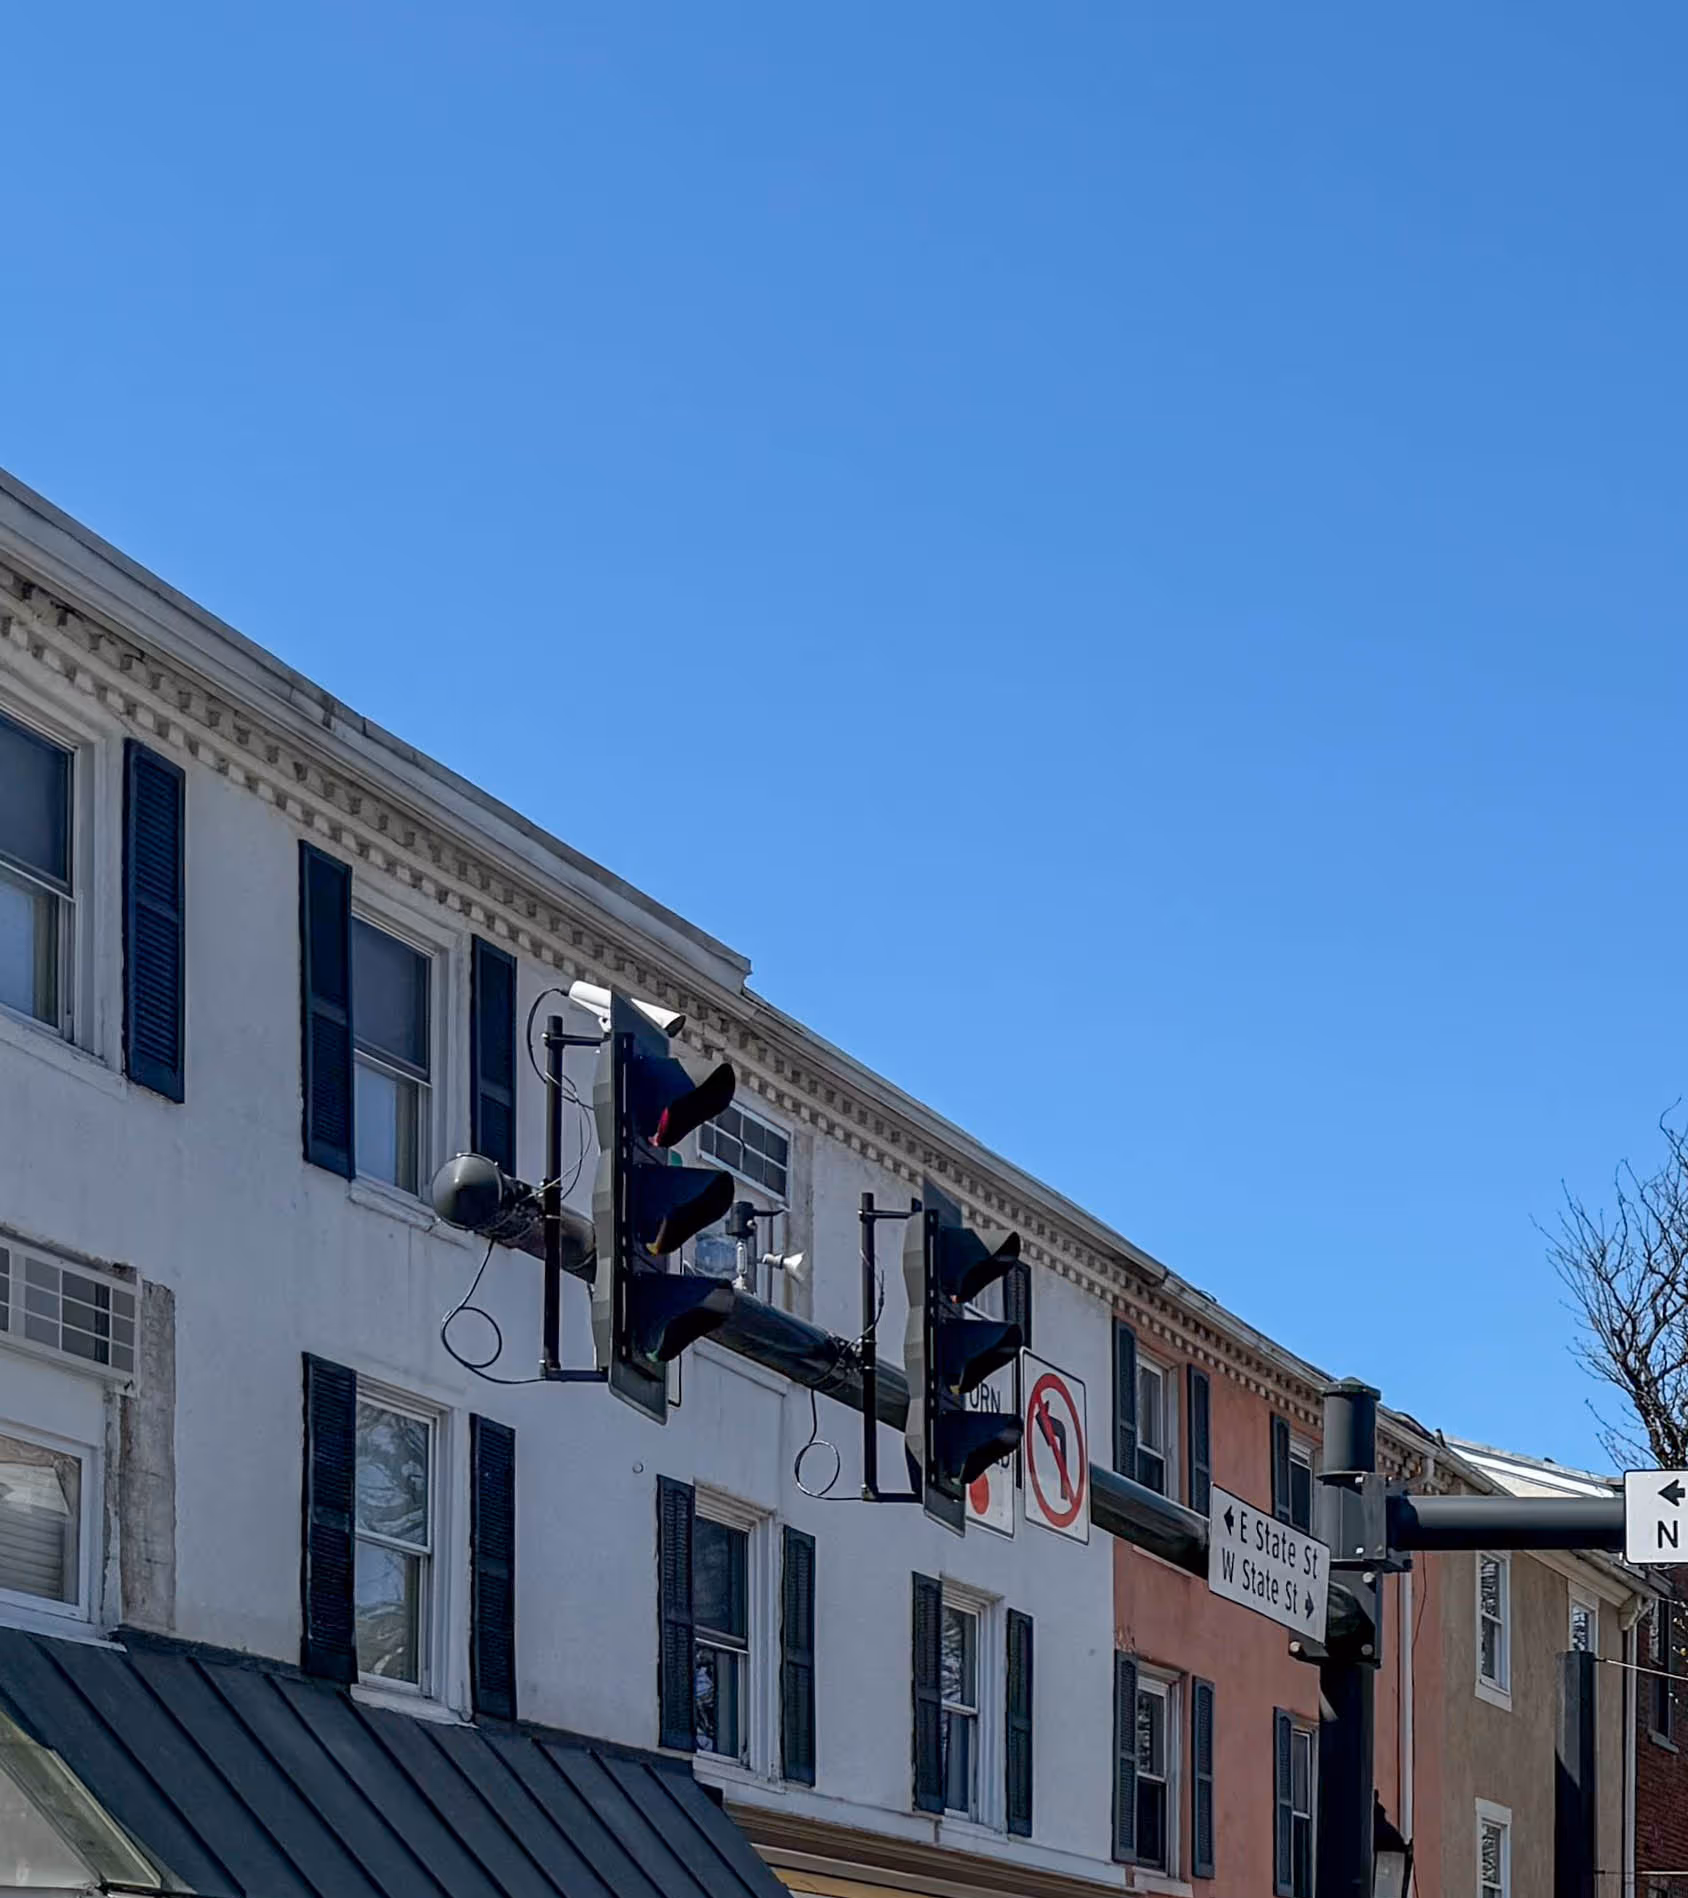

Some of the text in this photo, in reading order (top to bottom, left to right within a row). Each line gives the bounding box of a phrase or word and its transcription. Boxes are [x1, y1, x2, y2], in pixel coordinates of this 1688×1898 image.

[1240, 1511, 1317, 1580] E State St
[1657, 1520, 1679, 1548] N
[1222, 1547, 1297, 1614] W State St
